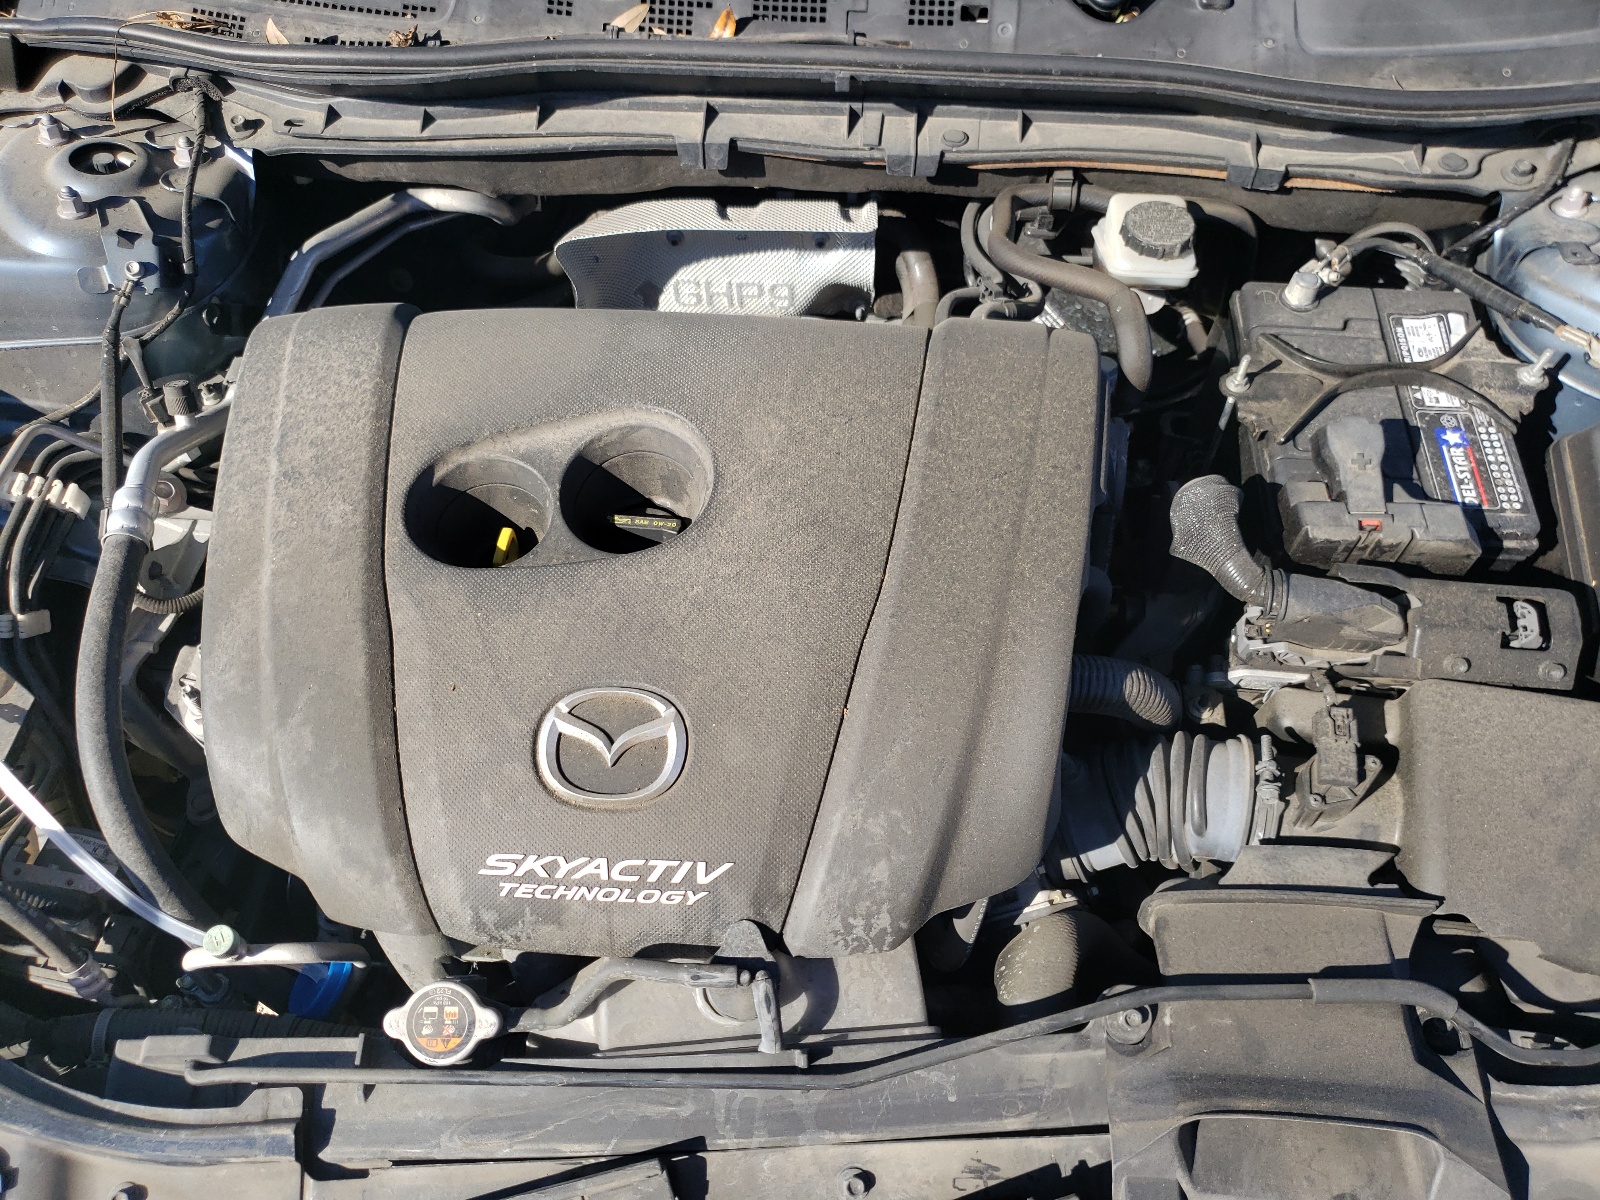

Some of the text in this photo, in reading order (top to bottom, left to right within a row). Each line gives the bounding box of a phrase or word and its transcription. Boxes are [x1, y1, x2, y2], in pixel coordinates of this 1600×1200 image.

[672, 278, 794, 311] GHP9
[477, 853, 735, 885] SKYACTIV
[499, 882, 710, 906] TECHNOLOGY
[436, 987, 452, 995] FL22
